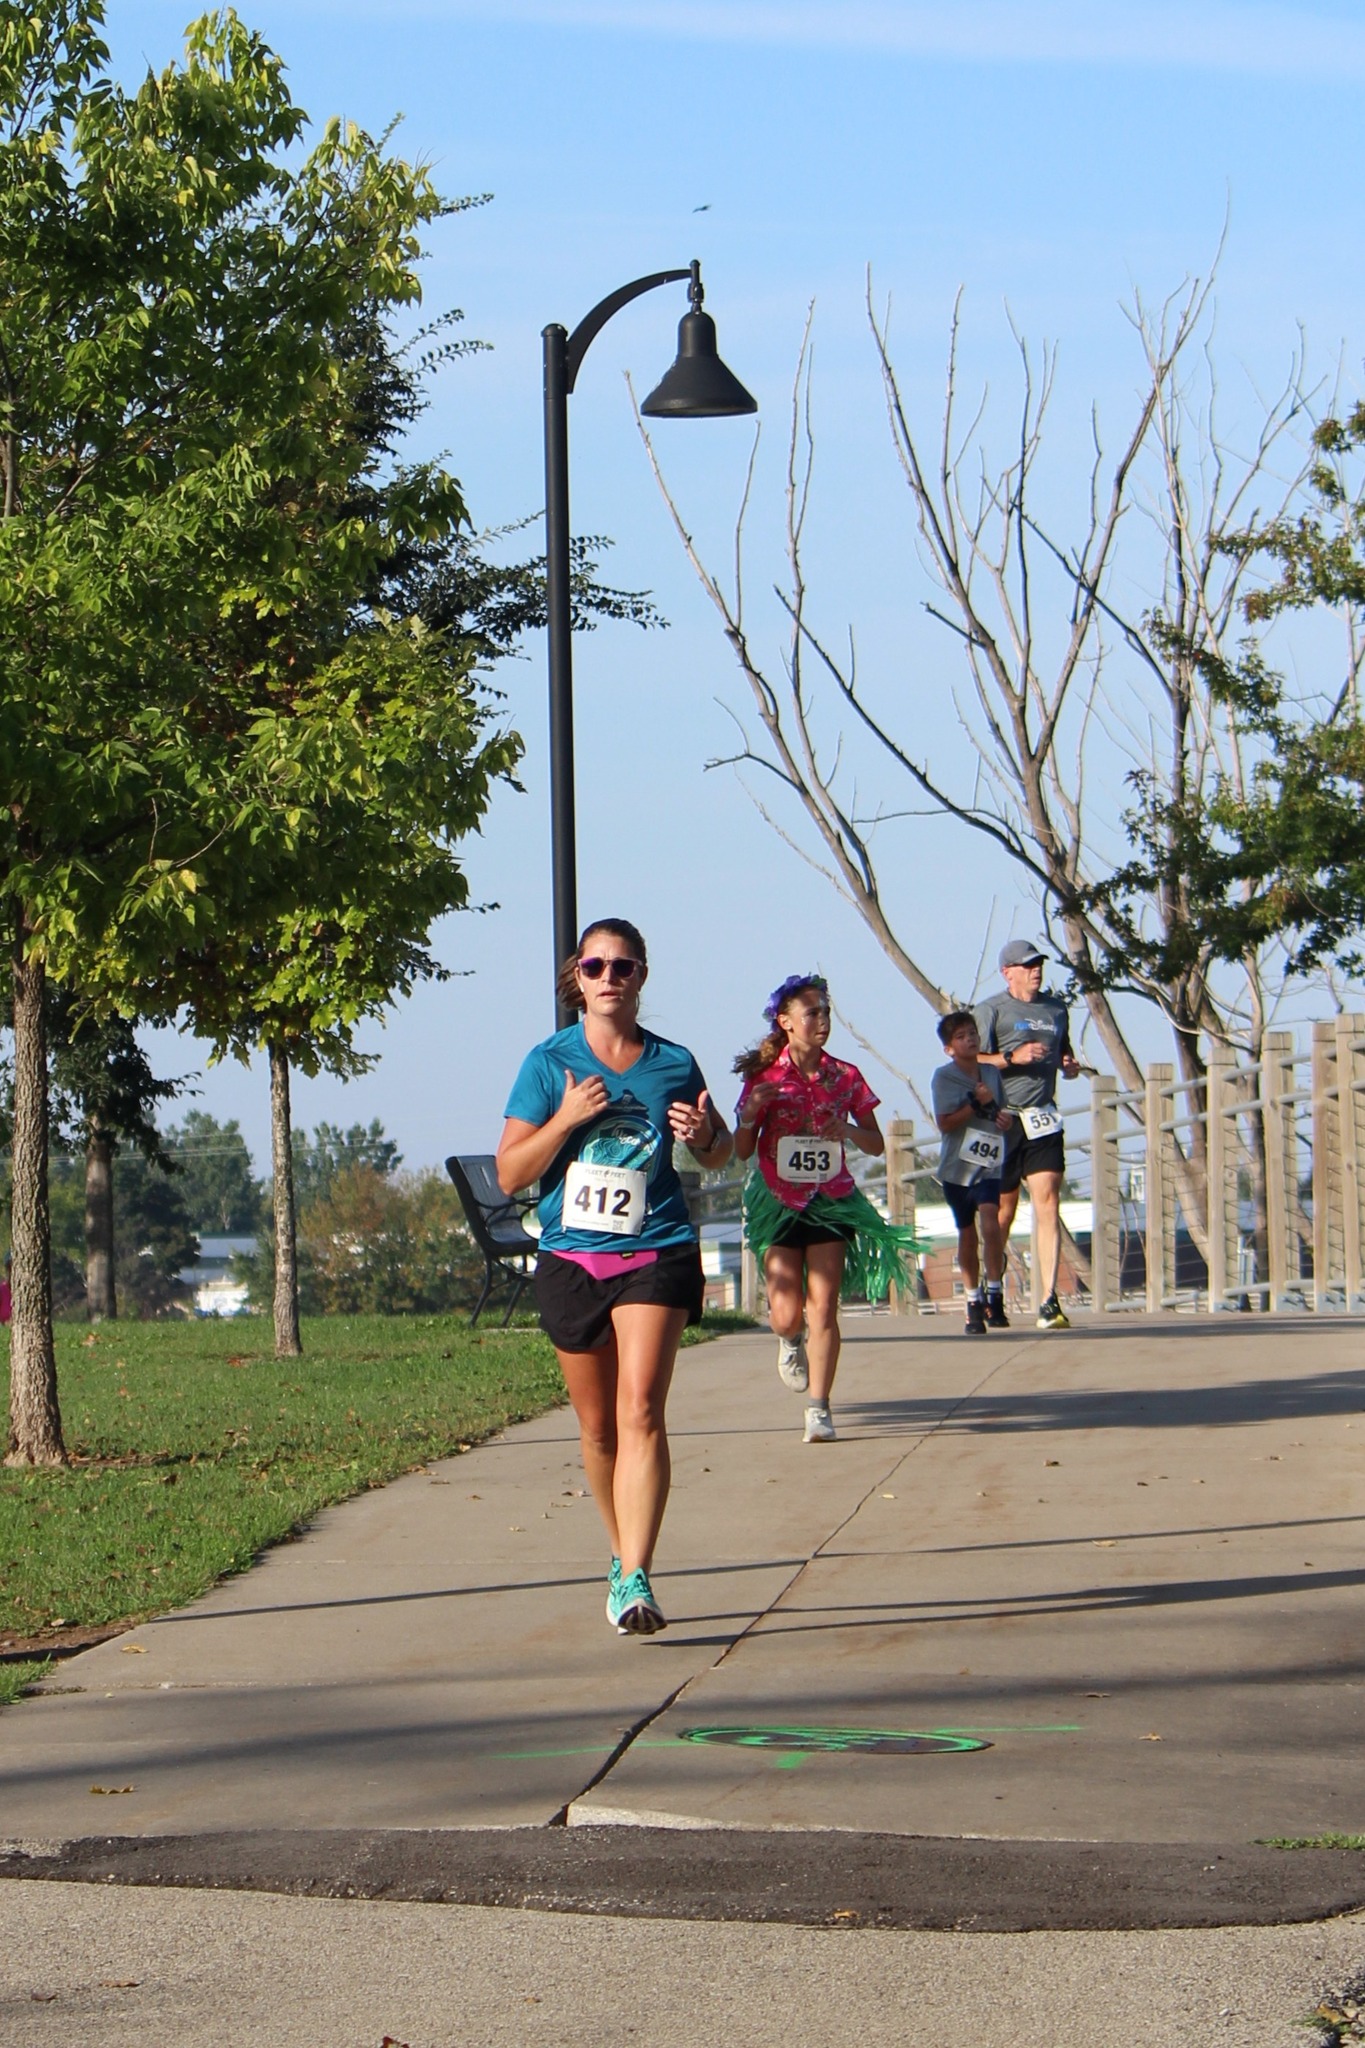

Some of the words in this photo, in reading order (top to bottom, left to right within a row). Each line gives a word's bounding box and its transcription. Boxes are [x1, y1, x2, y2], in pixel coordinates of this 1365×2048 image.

[970, 1141, 999, 1160] 494
[788, 1151, 830, 1171] 453
[575, 1186, 631, 1217] 412
